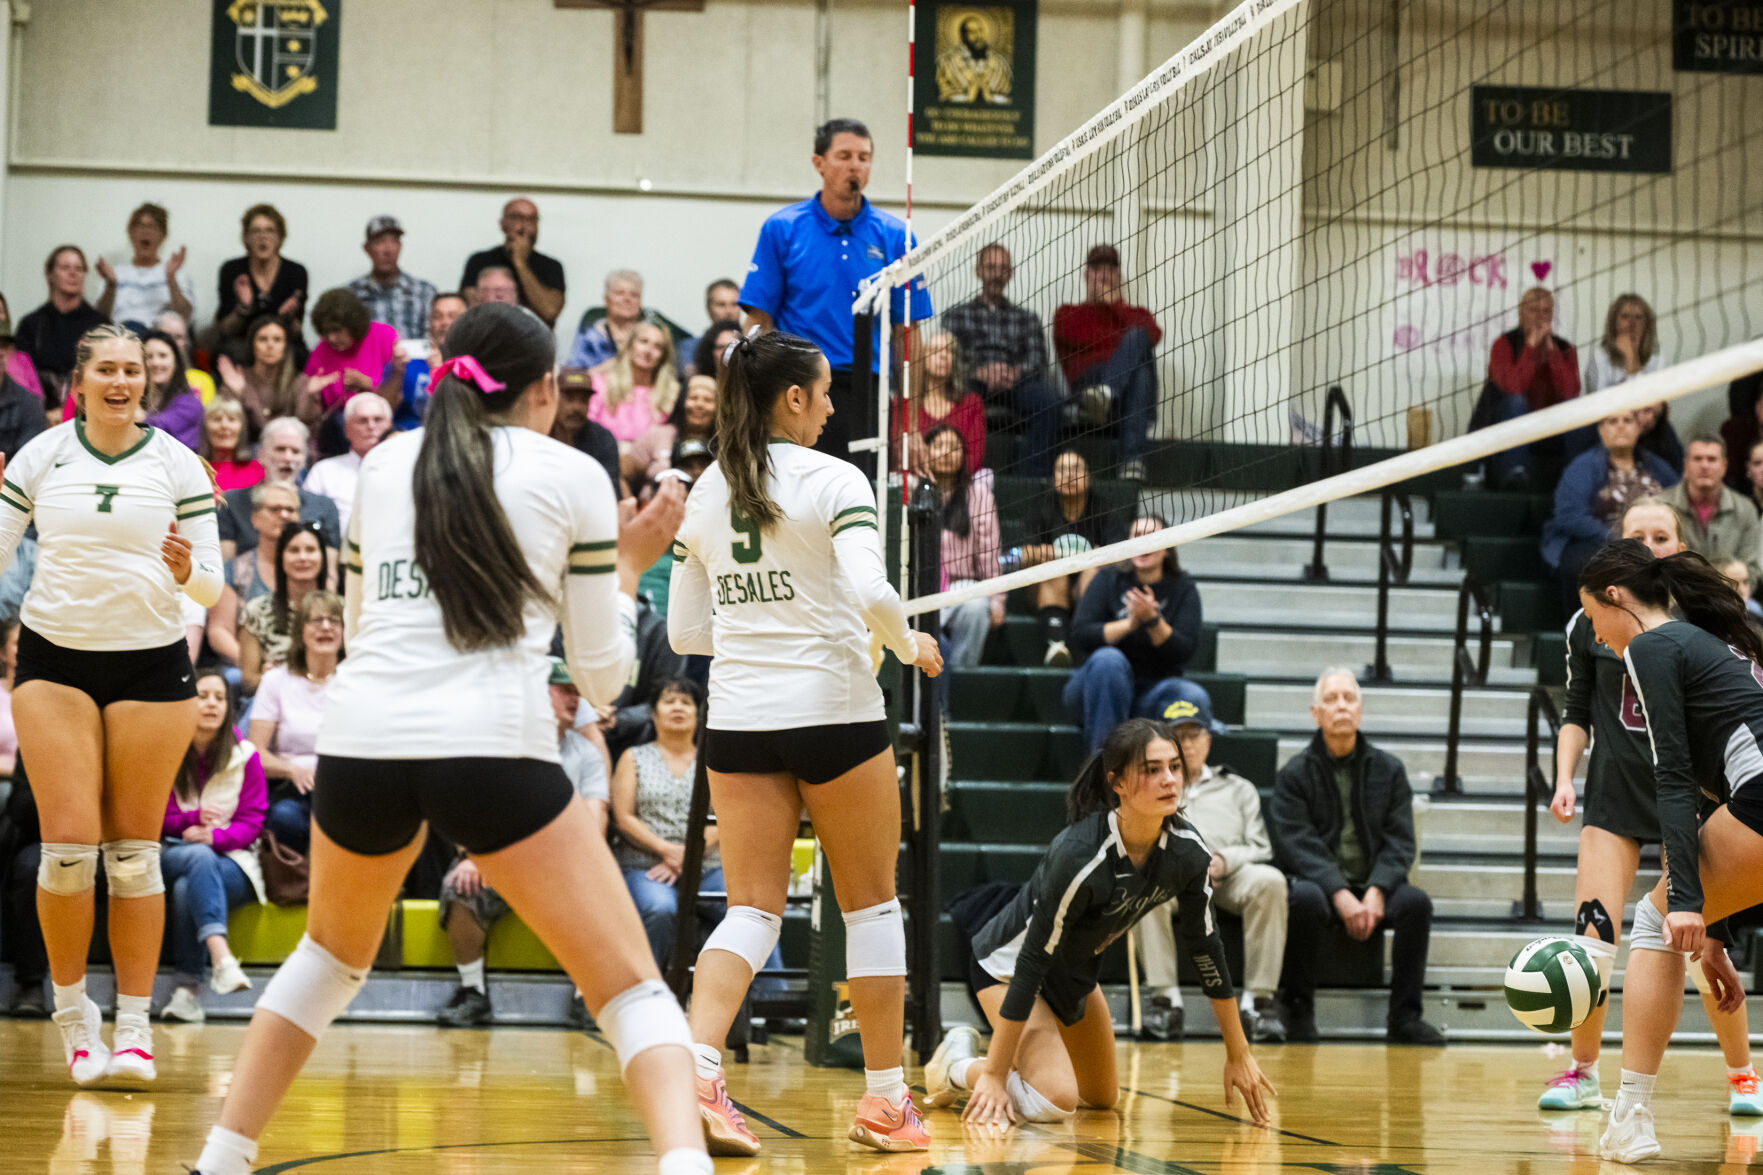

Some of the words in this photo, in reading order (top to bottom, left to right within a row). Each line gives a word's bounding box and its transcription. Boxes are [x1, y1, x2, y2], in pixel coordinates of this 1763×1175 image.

[1484, 100, 1522, 125] TO
[1531, 101, 1571, 127] BE
[1493, 129, 1555, 156] OUR
[1562, 131, 1634, 159] BEST
[95, 484, 119, 513] 7
[716, 570, 795, 605] DESALES
